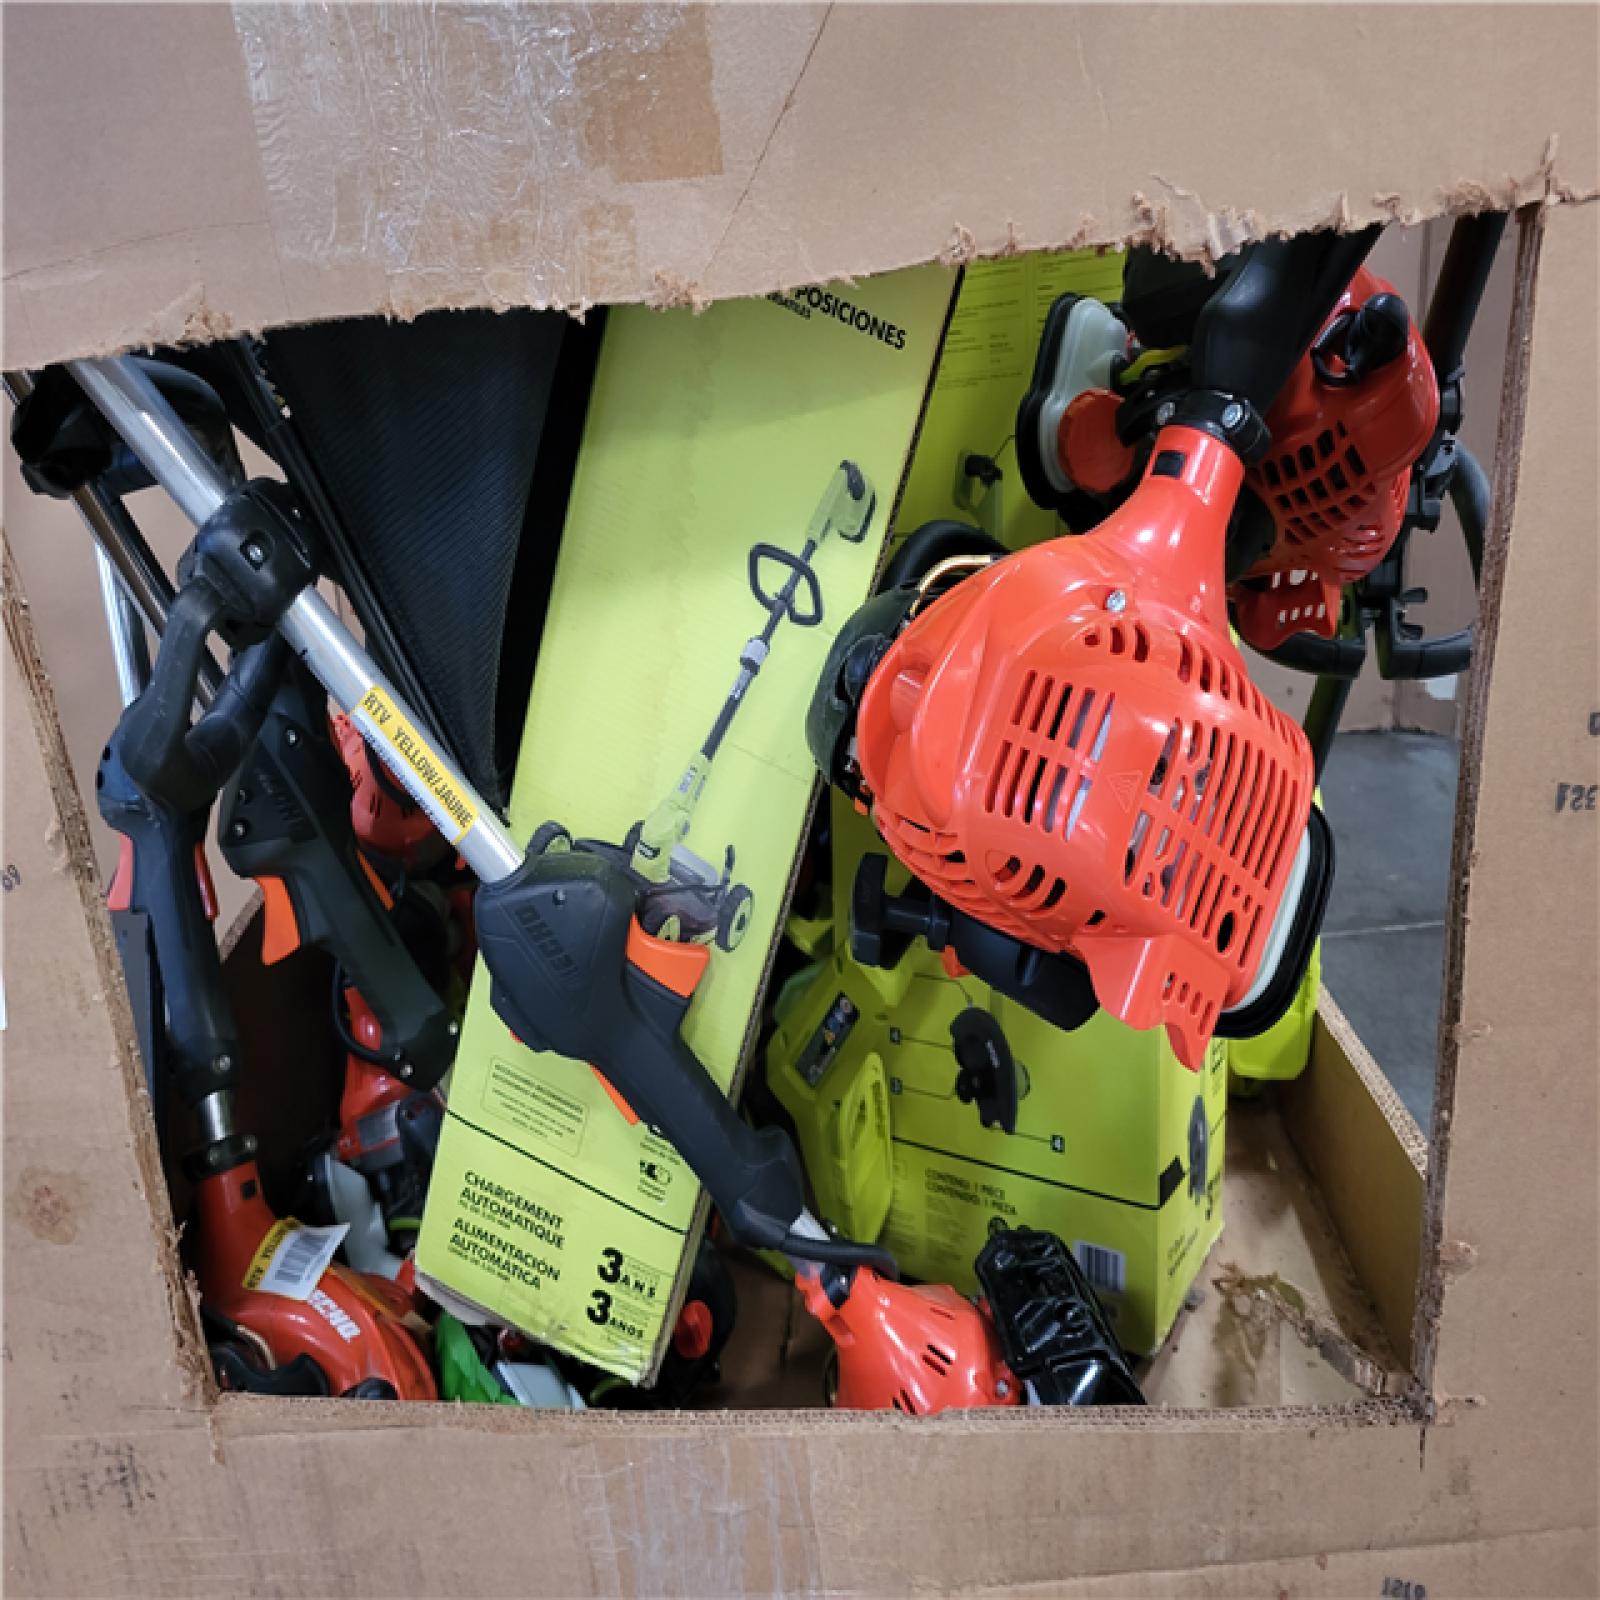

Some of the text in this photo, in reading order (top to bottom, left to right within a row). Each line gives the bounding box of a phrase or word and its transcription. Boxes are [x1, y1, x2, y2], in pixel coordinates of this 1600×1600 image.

[460, 1187, 565, 1250] AUTOMATIQUE
[464, 1170, 563, 1230] CHARGEMENT
[597, 1246, 624, 1284] 3
[586, 1289, 612, 1326] 3
